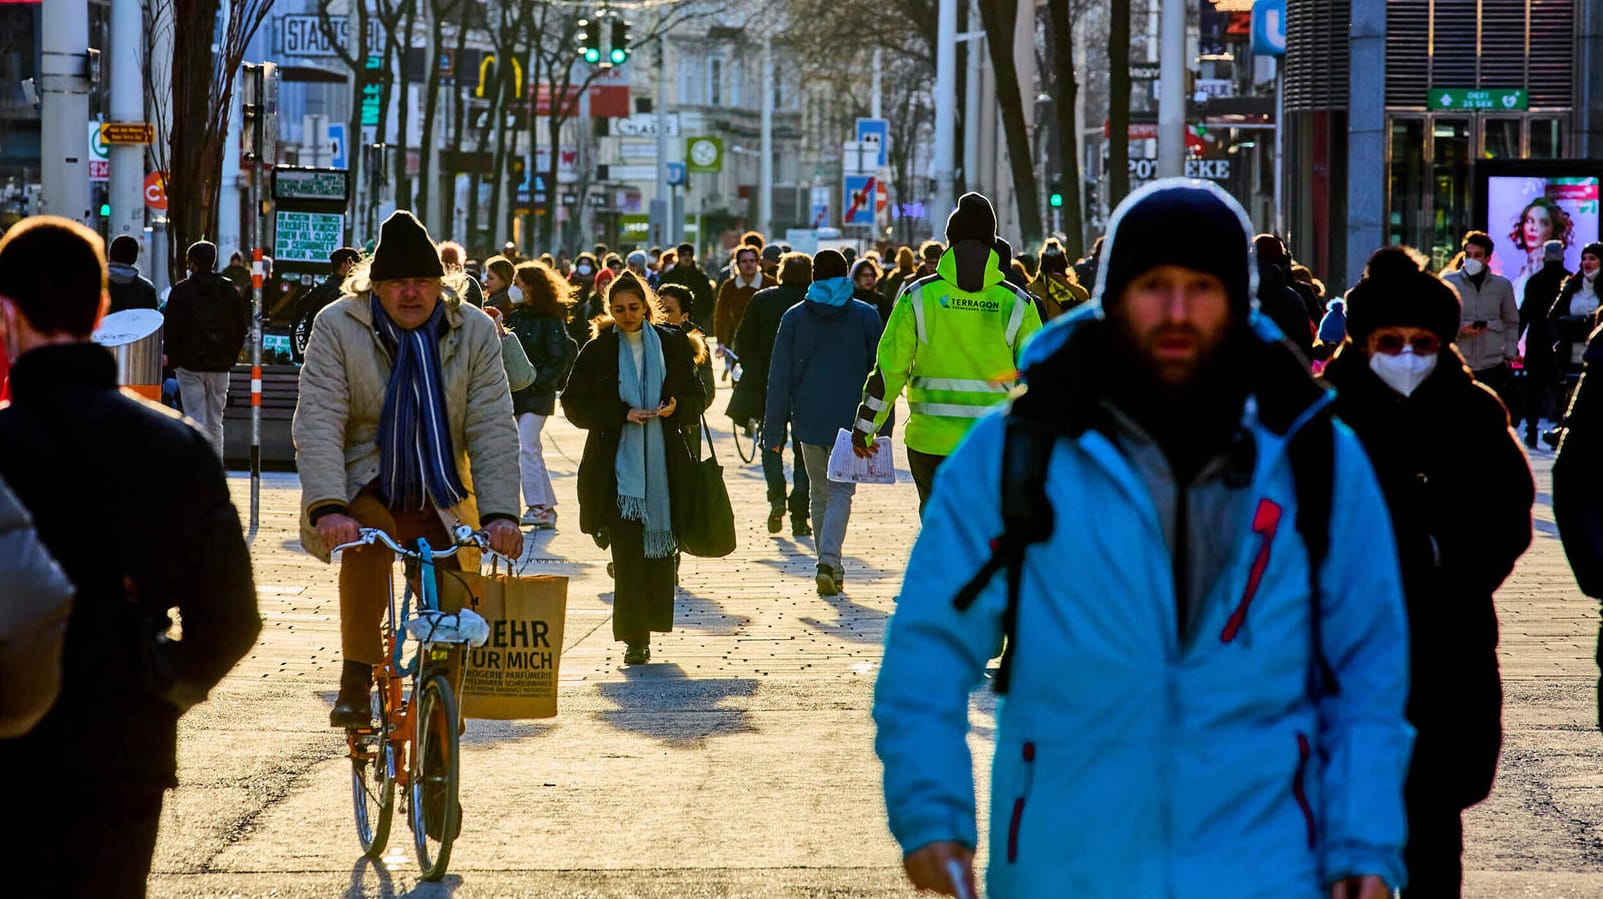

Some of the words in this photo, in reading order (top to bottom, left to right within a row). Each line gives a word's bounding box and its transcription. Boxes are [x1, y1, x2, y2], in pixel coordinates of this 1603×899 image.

[951, 298, 1000, 309] TERRAGON
[482, 619, 550, 648] EHR
[507, 651, 552, 669] MICH
